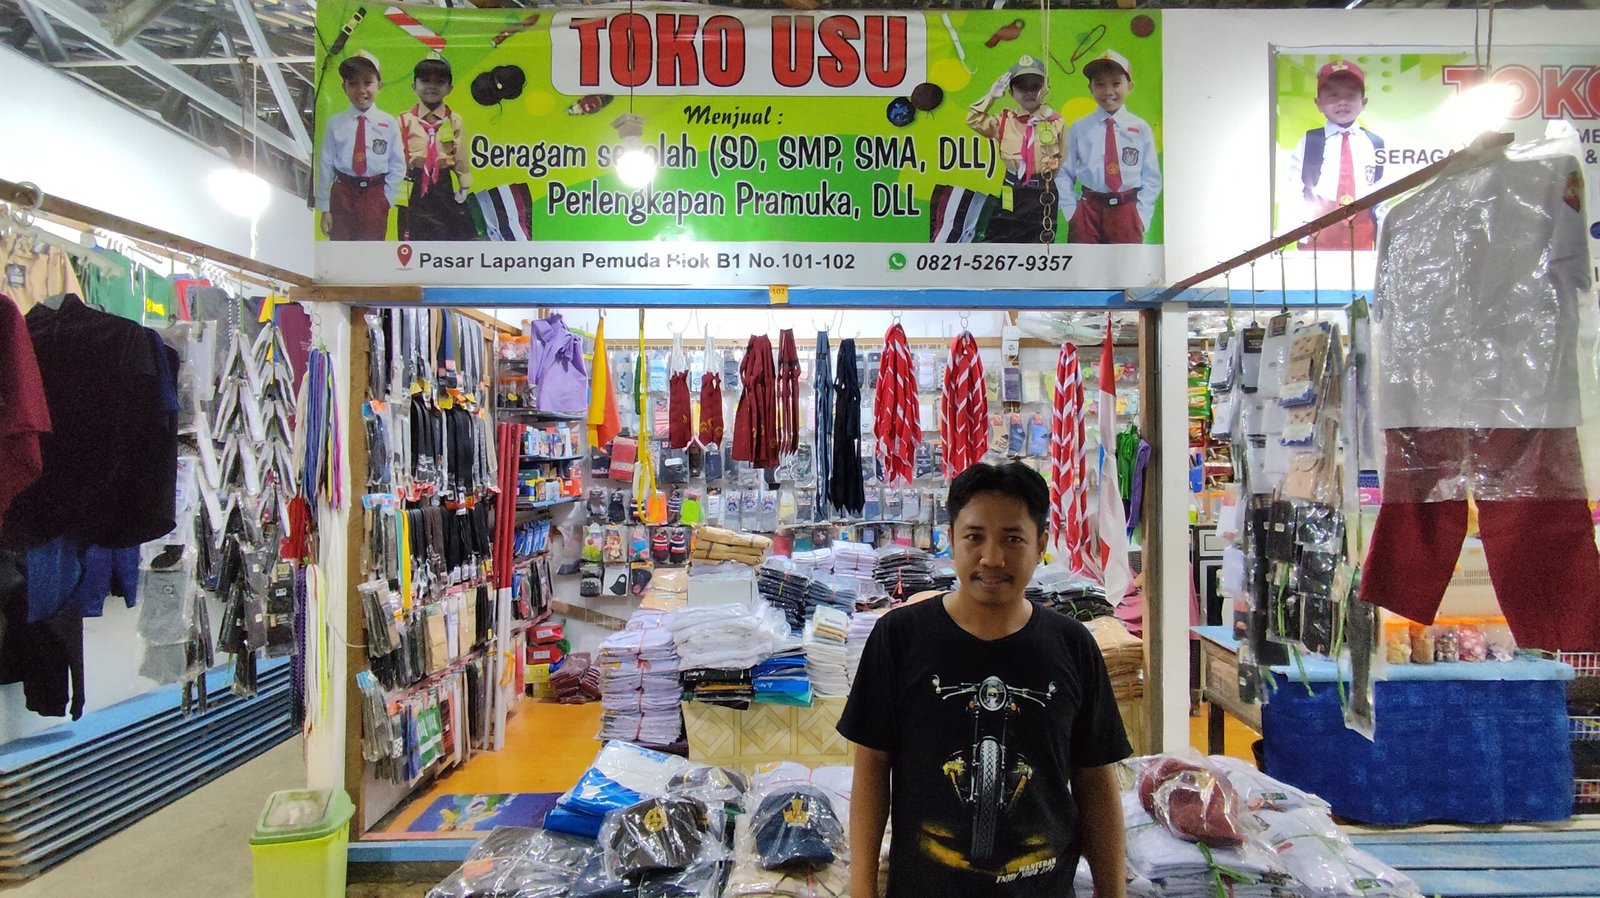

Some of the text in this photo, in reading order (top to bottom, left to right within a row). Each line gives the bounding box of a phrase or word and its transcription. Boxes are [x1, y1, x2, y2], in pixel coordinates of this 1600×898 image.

[569, 13, 907, 87] TOKO USU
[684, 106, 771, 128] Menjual
[471, 136, 586, 178] Seragam
[709, 135, 767, 178] (SD,
[778, 136, 842, 173] SMP,
[855, 136, 926, 173] SMA,
[939, 136, 997, 178] DLL)
[548, 181, 920, 225] Perlengkapan Pramuka, DLL
[419, 253, 475, 269] Pasar
[481, 253, 574, 273] Lapangan
[582, 252, 661, 269] Pemuda
[717, 252, 741, 269] B1
[749, 252, 855, 269] No.101-102
[916, 255, 1073, 272] 0821-5267-9357
